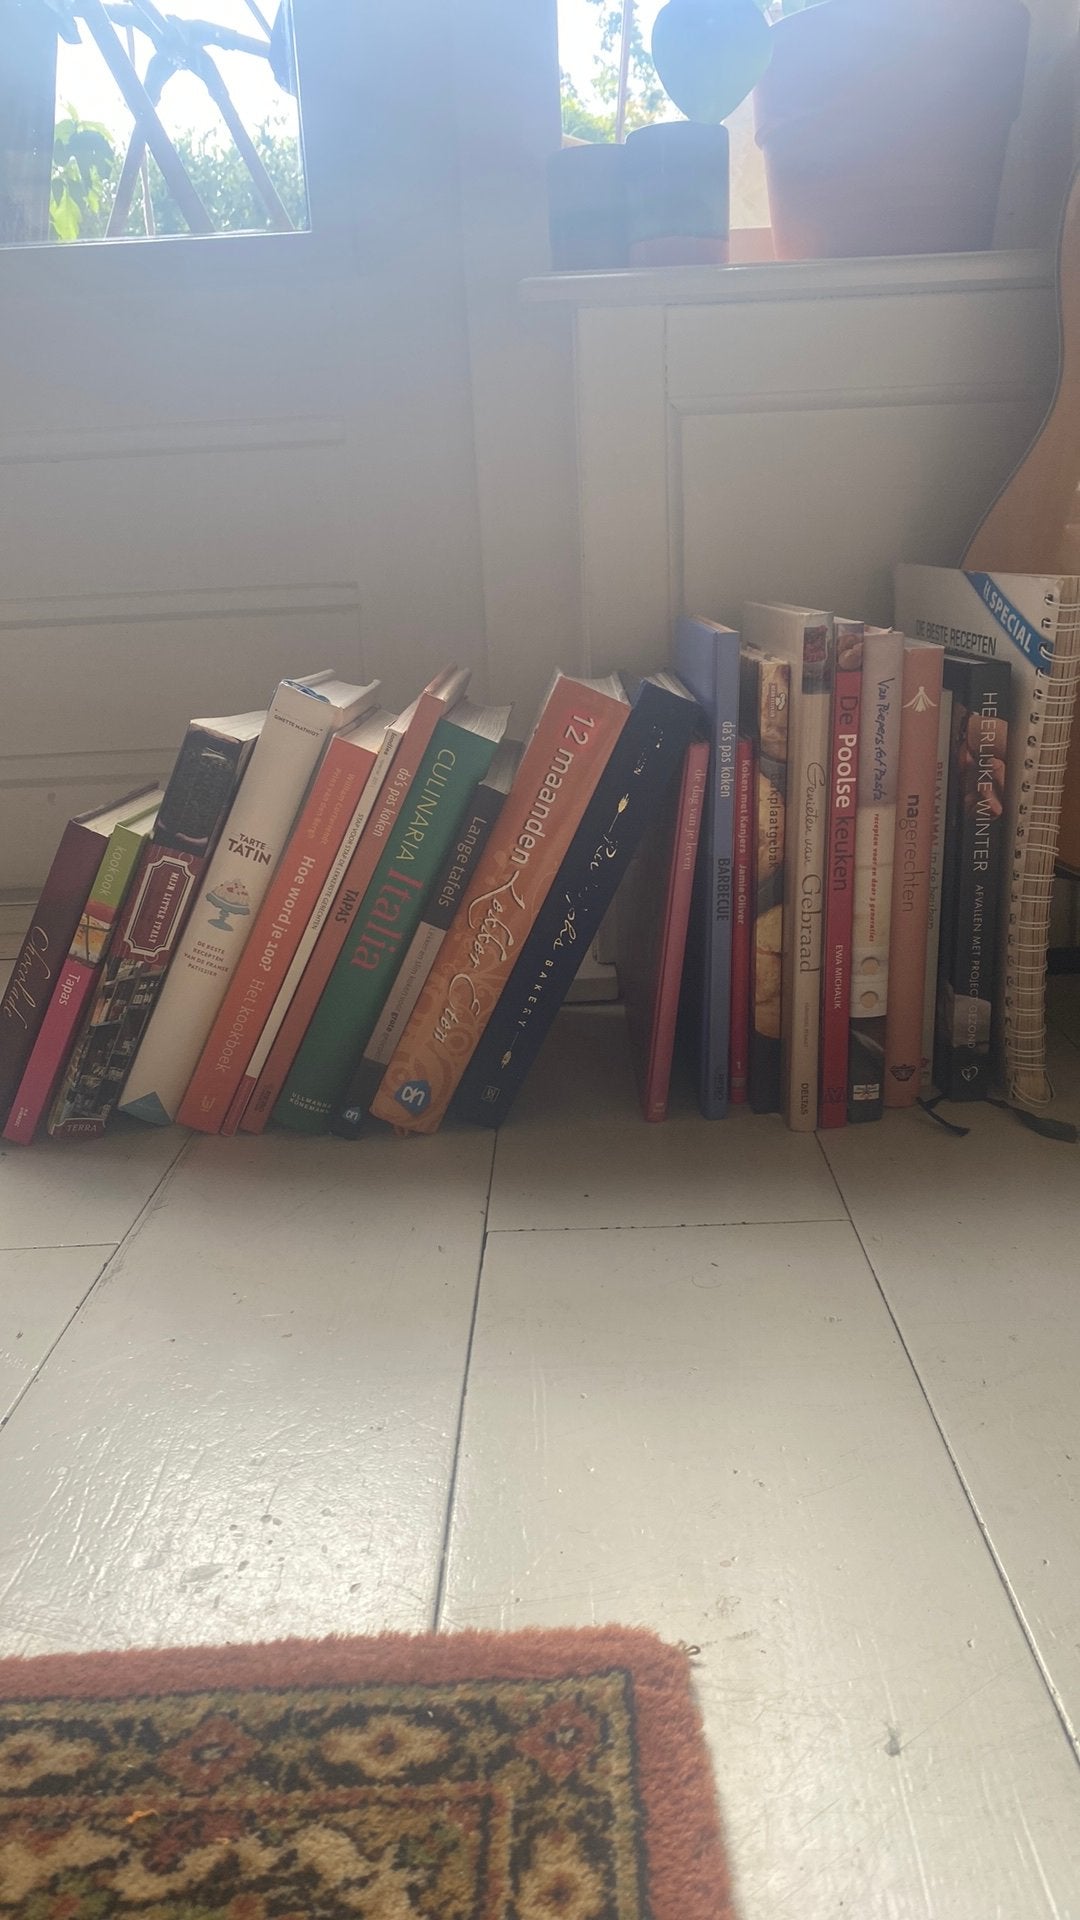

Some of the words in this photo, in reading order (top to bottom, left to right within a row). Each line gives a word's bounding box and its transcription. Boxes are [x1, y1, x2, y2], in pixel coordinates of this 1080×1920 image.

[990, 592, 1030, 652] SPECIAL
[927, 622, 948, 643] BESTE
[951, 628, 997, 656] RECEPTEN
[877, 677, 894, 699] Van
[839, 695, 858, 725] De
[874, 702, 889, 744] Piepers
[565, 714, 595, 746] 12
[721, 720, 735, 741] da's
[977, 691, 997, 791] HEERLIJKE
[718, 745, 732, 762] pas
[392, 766, 411, 789] da's
[694, 768, 705, 783] de
[719, 766, 734, 797] koken
[740, 759, 749, 791] Koken
[835, 733, 857, 808] Poolse
[872, 765, 887, 801] Pasta
[382, 786, 400, 806] pas
[394, 749, 456, 859] CULINARIA
[510, 746, 575, 865] maanden
[688, 784, 703, 805] dag
[805, 762, 825, 832] Genieten
[354, 813, 363, 827] STAP
[371, 806, 396, 838] koken
[688, 807, 699, 826] van
[766, 772, 780, 869] Bakplaatgebak
[871, 813, 879, 845] recepten
[240, 833, 266, 850] TARTE
[346, 827, 358, 845] VOOR
[455, 816, 487, 864] Lange
[683, 827, 697, 840] je
[736, 816, 747, 853] Kanjers
[972, 798, 991, 871] WINTER
[228, 838, 272, 866] TATIN
[337, 858, 345, 866] DE
[682, 842, 696, 871] leven
[803, 838, 813, 864] van
[832, 815, 854, 891] keuken
[898, 794, 925, 912] nagerechten
[165, 871, 179, 891] MIJN
[293, 854, 315, 885] Hoe
[324, 867, 341, 897] LEKKERSTE
[737, 864, 746, 892] Jamie
[437, 867, 463, 906] tafels
[715, 857, 730, 920] BARBECUE
[155, 891, 172, 919] LITTLE
[277, 885, 302, 925] word
[310, 896, 329, 930] GERECHTEN
[334, 887, 359, 924] TAPAS
[351, 867, 423, 968] Italia
[468, 870, 524, 968] Lekker
[736, 895, 746, 925] Oliver
[972, 884, 984, 931] AFVALLEN
[146, 920, 162, 944] ITALY
[268, 922, 287, 940] je
[799, 874, 821, 973] Gebraad
[192, 948, 224, 962] RECEPTEN
[258, 940, 279, 972] 100?
[834, 944, 842, 964] EWA
[971, 936, 981, 955] MET
[2, 926, 50, 1029] Chocolade
[188, 964, 218, 977] PATISSIER
[968, 960, 979, 1000] PROJECT
[58, 975, 81, 1005] Tapas
[244, 977, 264, 1004] Het
[516, 958, 554, 1028] BAKERY
[833, 967, 842, 1008] MICHALIK
[384, 1011, 399, 1032] grote
[433, 974, 480, 1043] Eten
[214, 1005, 254, 1075] kookboek
[967, 1006, 977, 1048] GEZOND
[799, 1082, 808, 1115] DELTAS
[67, 1124, 97, 1132] TERRA
